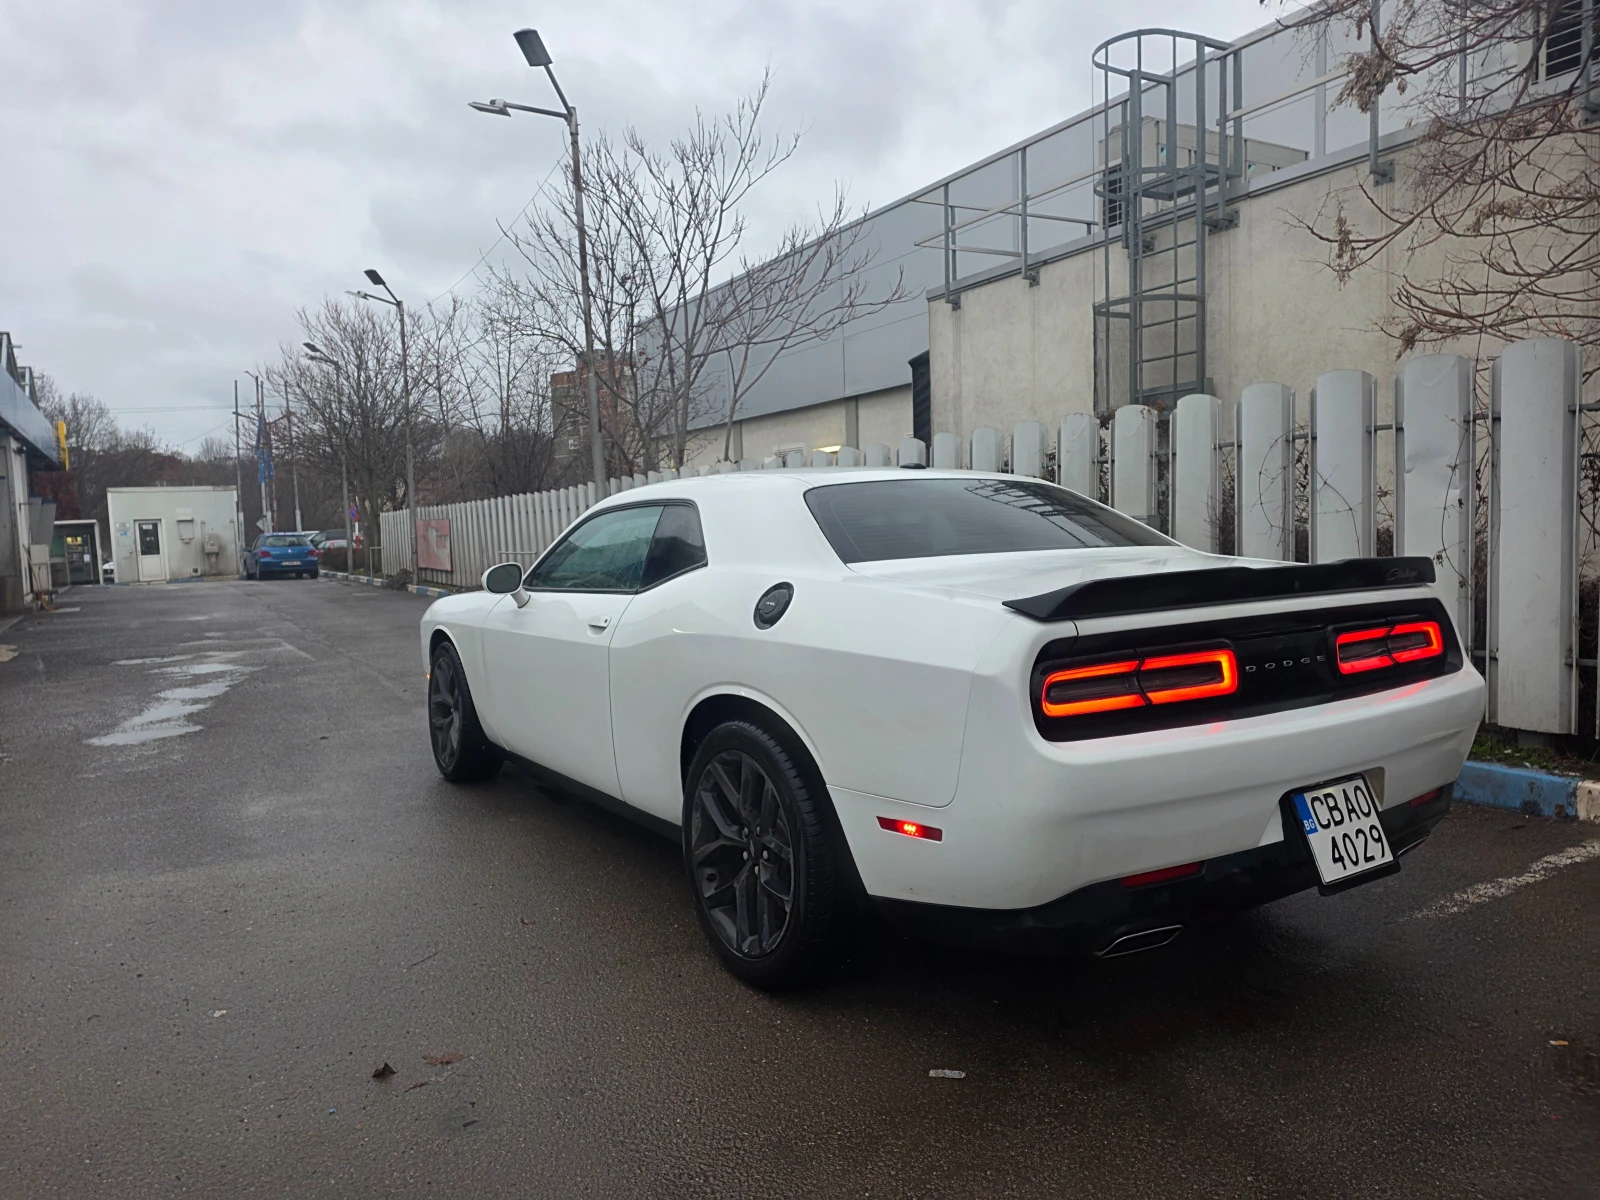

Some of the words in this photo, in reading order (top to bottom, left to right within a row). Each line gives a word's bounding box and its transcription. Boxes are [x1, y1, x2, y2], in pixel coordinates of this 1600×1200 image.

[1245, 655, 1325, 672] DODGE
[1303, 819, 1315, 831] BG
[1331, 824, 1385, 870] 4029
